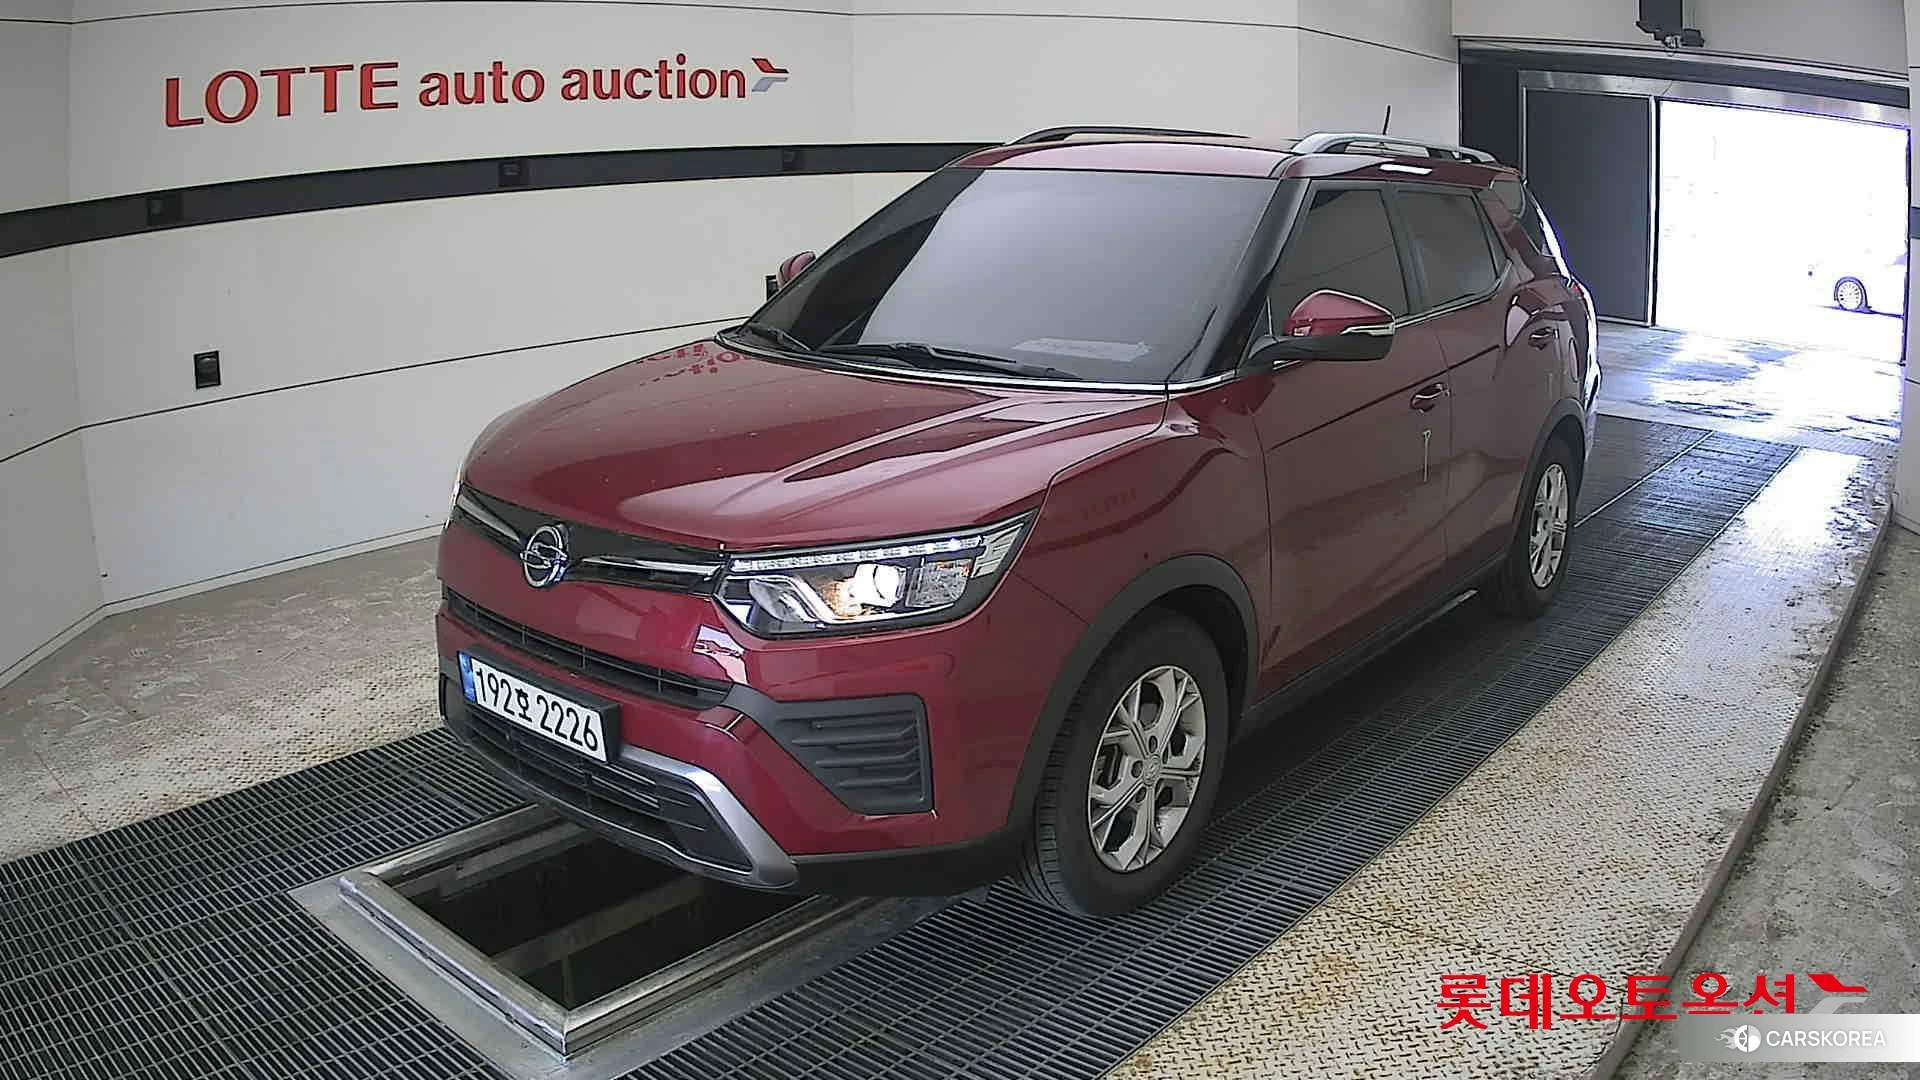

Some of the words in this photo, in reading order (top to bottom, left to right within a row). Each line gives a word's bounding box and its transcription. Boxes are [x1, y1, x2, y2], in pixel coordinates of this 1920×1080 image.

[165, 62, 400, 128] LOTTE
[418, 61, 545, 107] auto
[560, 53, 746, 101] auction
[476, 667, 533, 723] 192호
[536, 694, 598, 752] 2226
